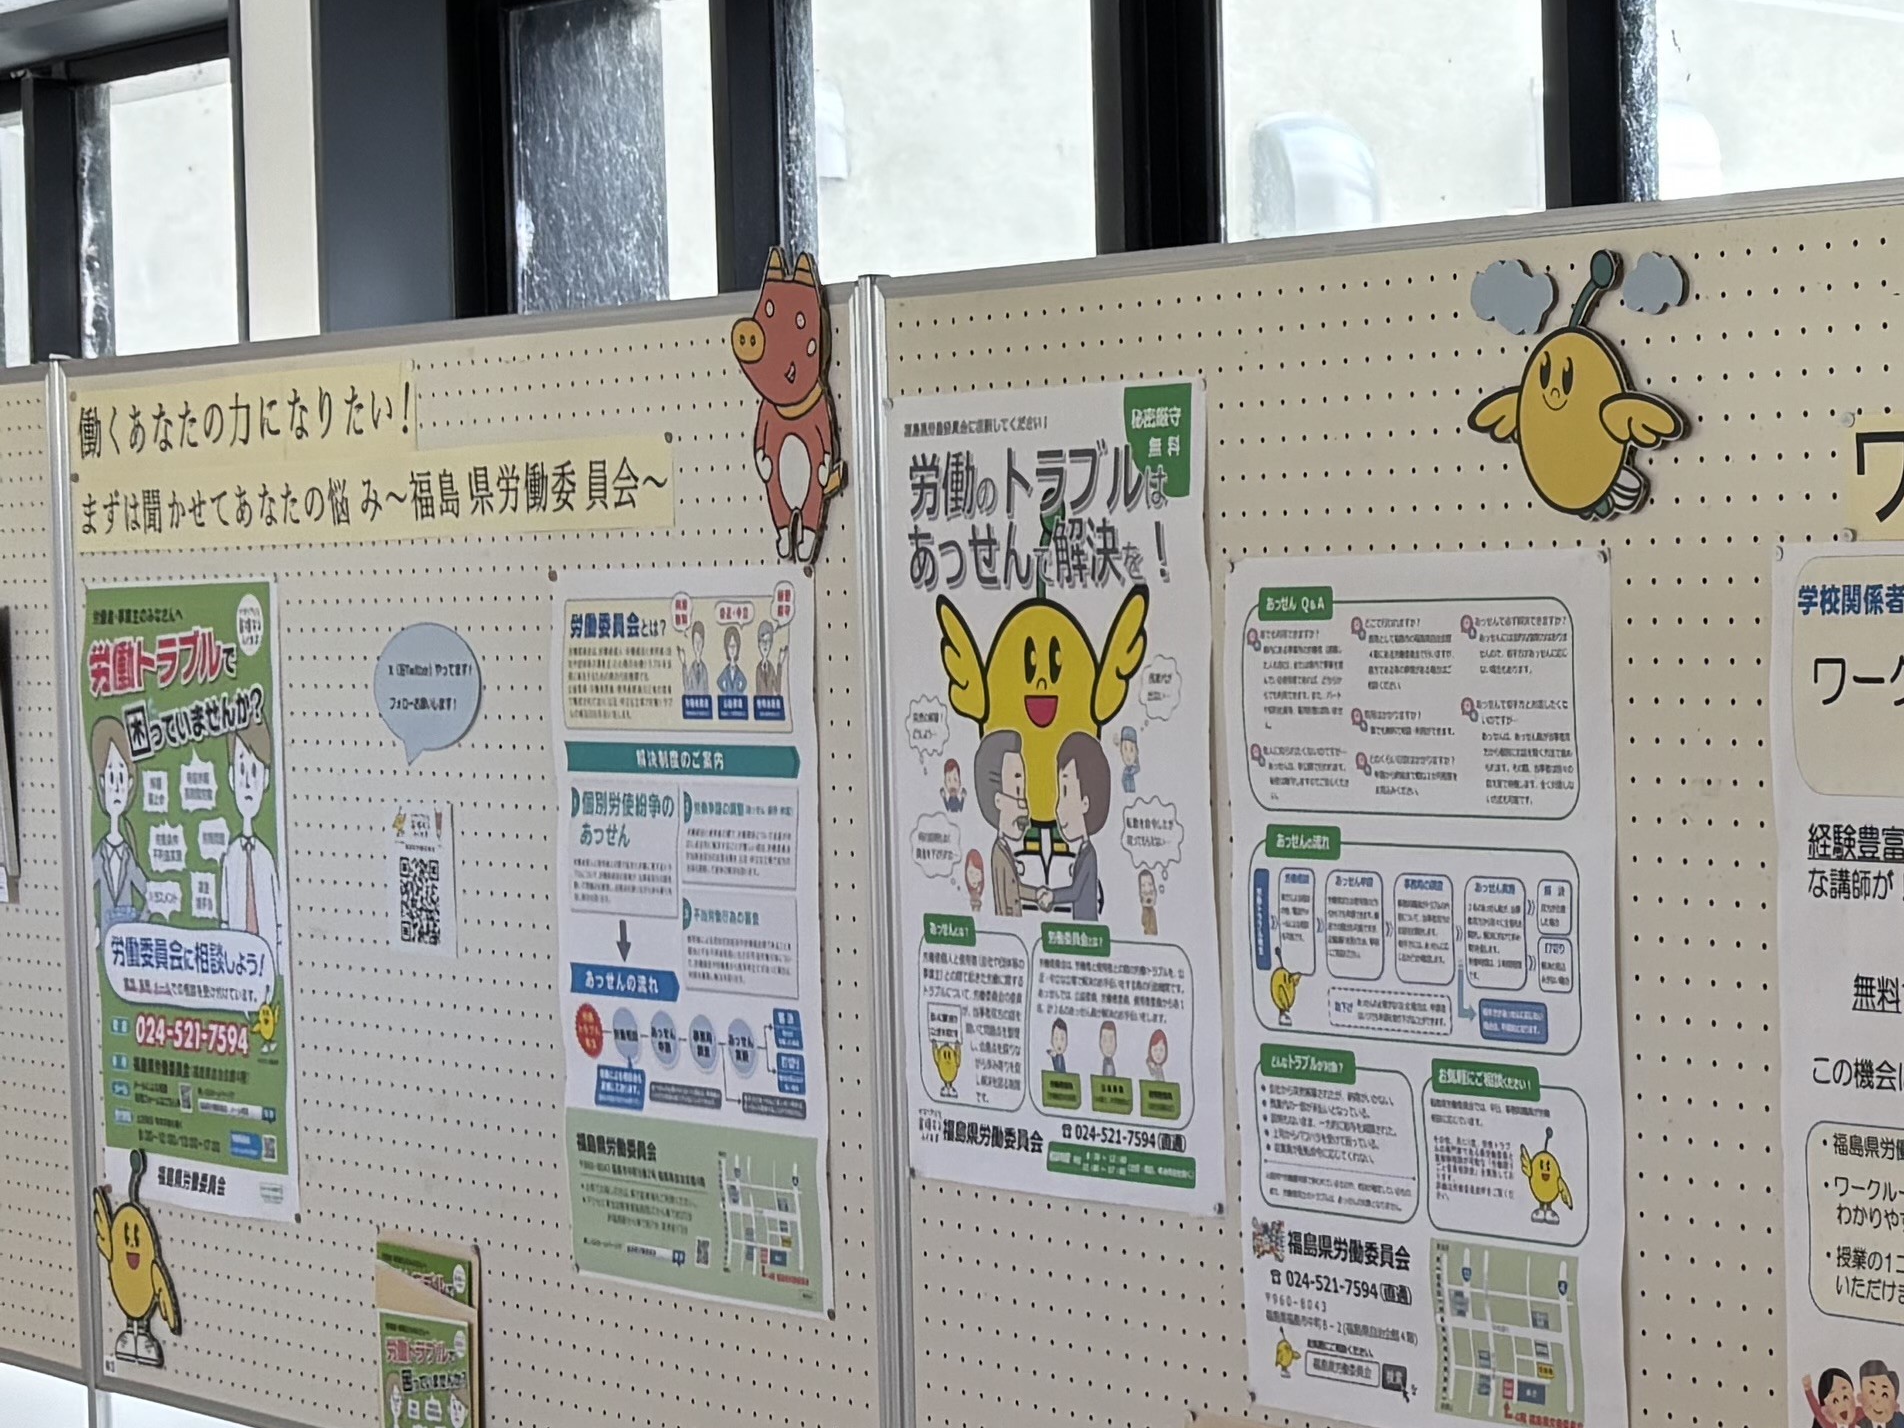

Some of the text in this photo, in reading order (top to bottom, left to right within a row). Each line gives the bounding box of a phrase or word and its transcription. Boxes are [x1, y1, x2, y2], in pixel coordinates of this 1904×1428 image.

[79, 381, 411, 460] 働くあなたの力になりたい！
[909, 438, 1168, 521] 労働のトラブルは
[908, 516, 1170, 591] あっせんで解決を！
[89, 626, 237, 695] 労働トラブルで
[125, 686, 264, 756] 困っていませんか？
[582, 787, 675, 819] 個別労使紛争の
[579, 823, 631, 848] あっせん
[111, 936, 265, 976] 労働委員会に相談しよう！
[585, 971, 658, 994] あっせんの流れ
[135, 1015, 249, 1055] 024-521-7594
[943, 1120, 1043, 1154] 福島県労働委員会
[1287, 1229, 1411, 1271] 福島県労働委員会
[1286, 1270, 1412, 1307] 024-521-7594(直通)
